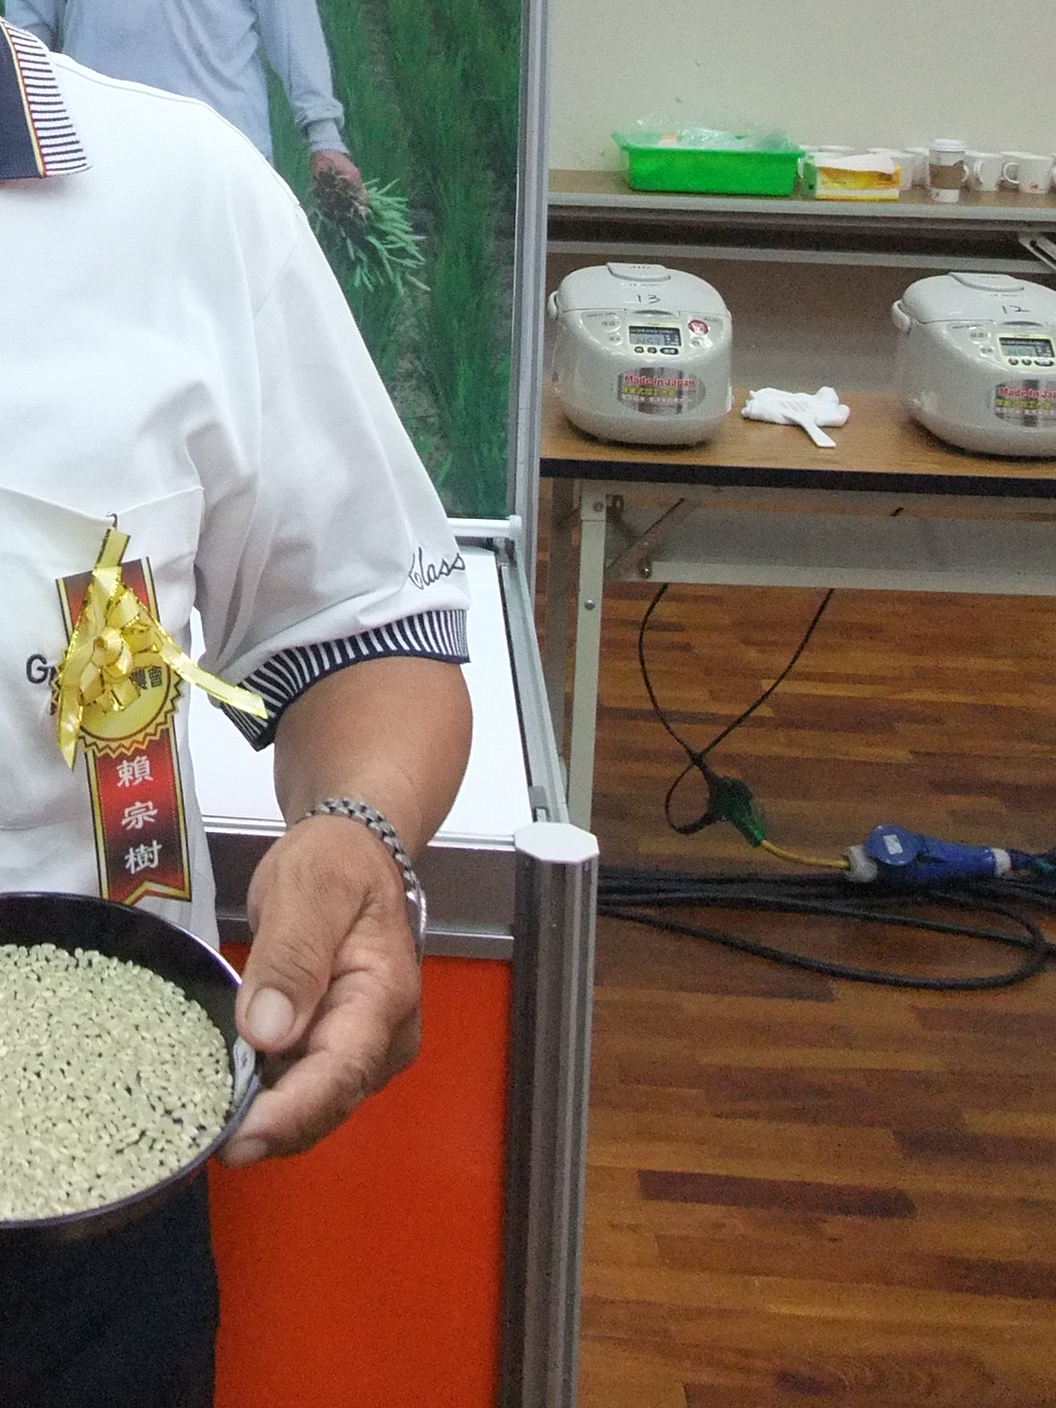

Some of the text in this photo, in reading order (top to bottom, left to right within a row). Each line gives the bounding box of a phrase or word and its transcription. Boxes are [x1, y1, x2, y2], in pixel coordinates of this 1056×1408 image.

[636, 293, 662, 305] 13
[1001, 304, 1031, 315] 12
[625, 375, 653, 386] Made
[665, 378, 696, 388] Japan
[999, 386, 1028, 397] Made
[115, 755, 163, 875] 賴宗樹
